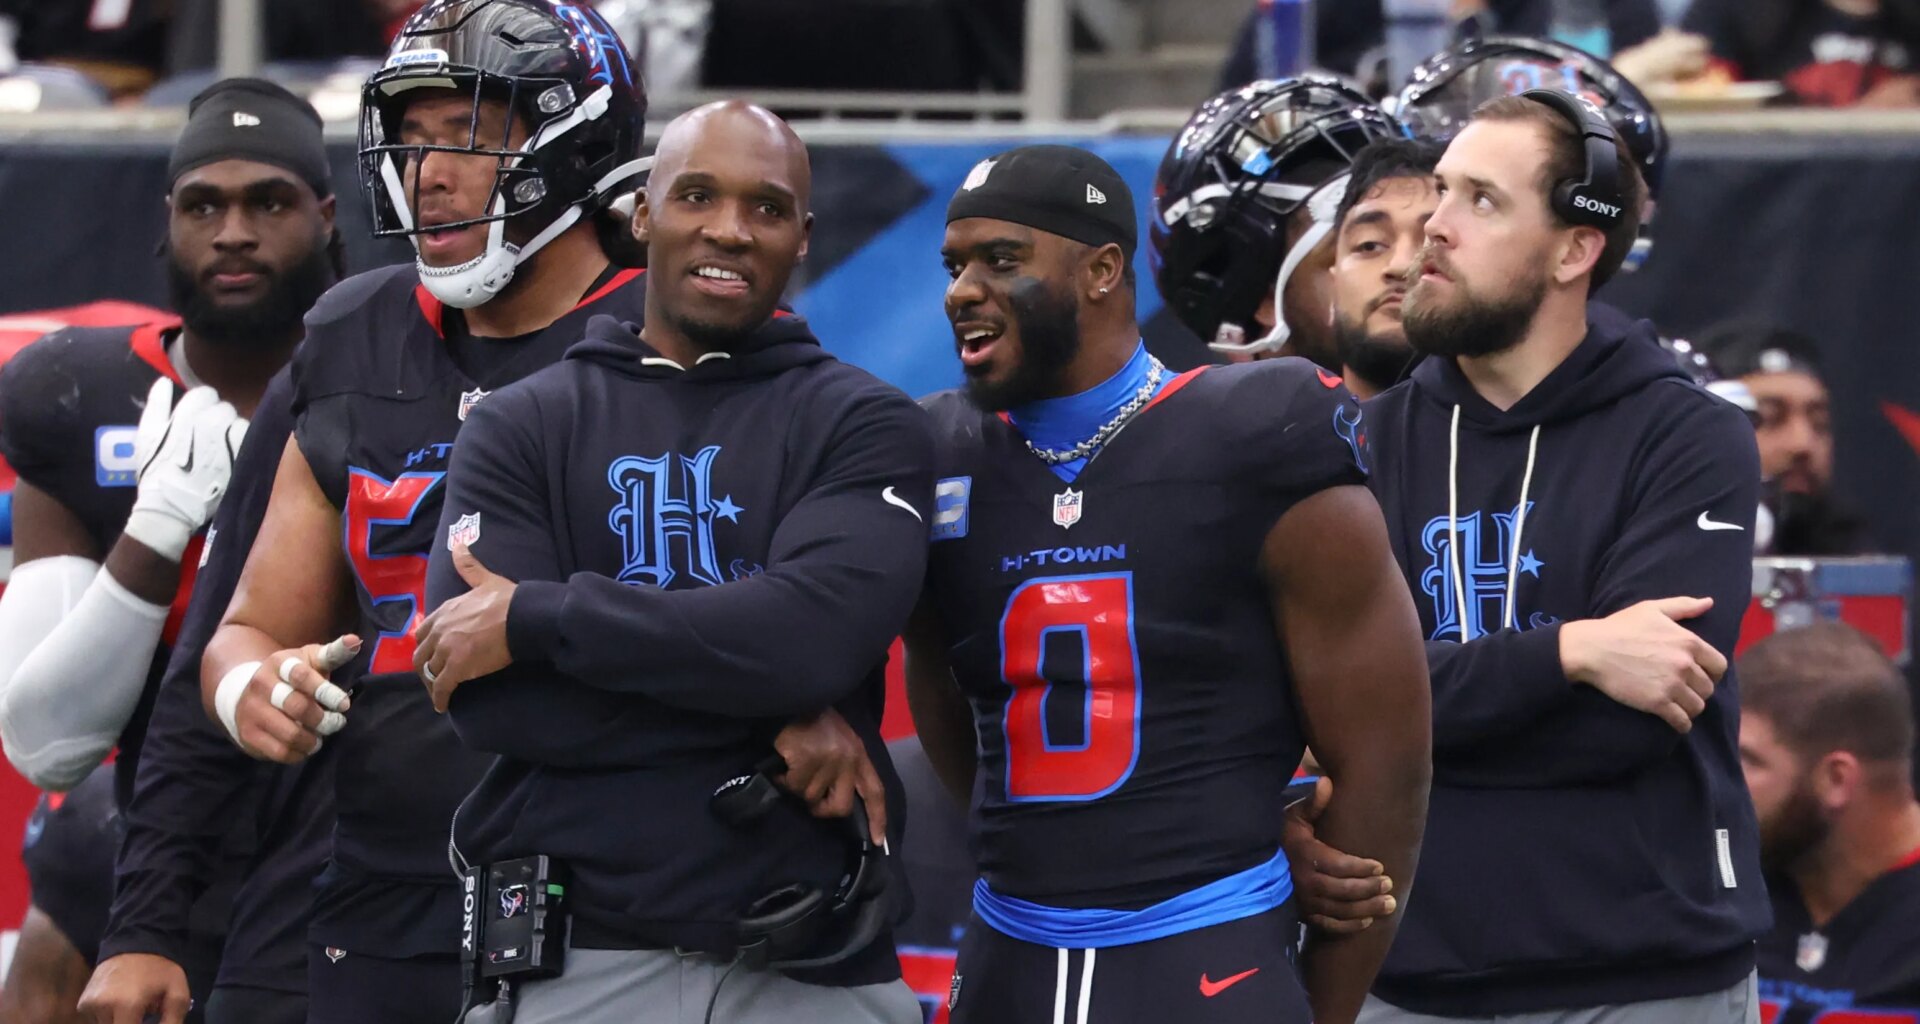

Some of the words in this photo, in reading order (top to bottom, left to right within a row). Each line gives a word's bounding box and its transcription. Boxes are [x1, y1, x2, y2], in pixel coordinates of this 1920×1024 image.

[1574, 195, 1622, 218] SONY
[342, 465, 449, 675] 5
[1001, 543, 1126, 572] H-TOWN
[999, 571, 1142, 802] 0
[462, 875, 476, 952] SONY
